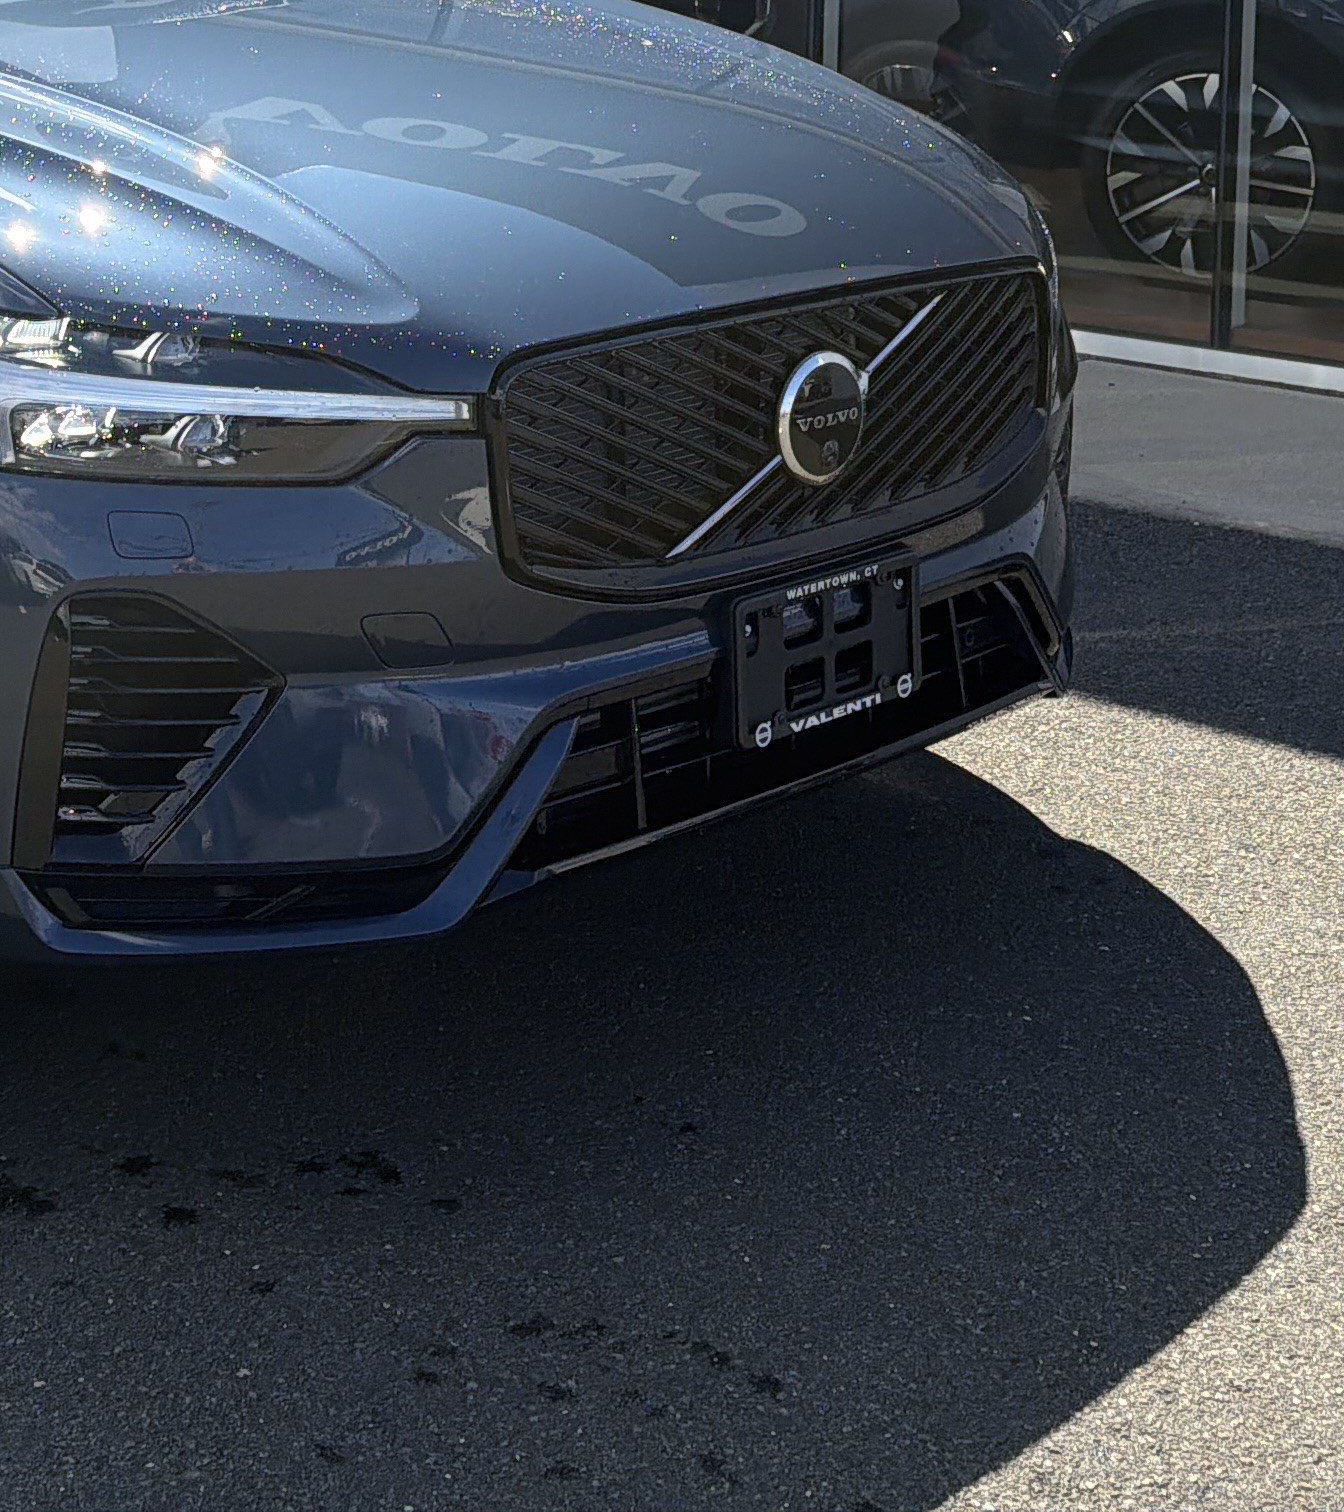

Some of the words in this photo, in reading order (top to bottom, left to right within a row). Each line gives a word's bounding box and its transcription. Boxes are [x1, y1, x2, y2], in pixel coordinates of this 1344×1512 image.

[796, 407, 859, 432] VOLVO
[786, 571, 861, 600] WATERTOWN,
[864, 564, 879, 577] CT
[789, 693, 882, 733] VALENTI
